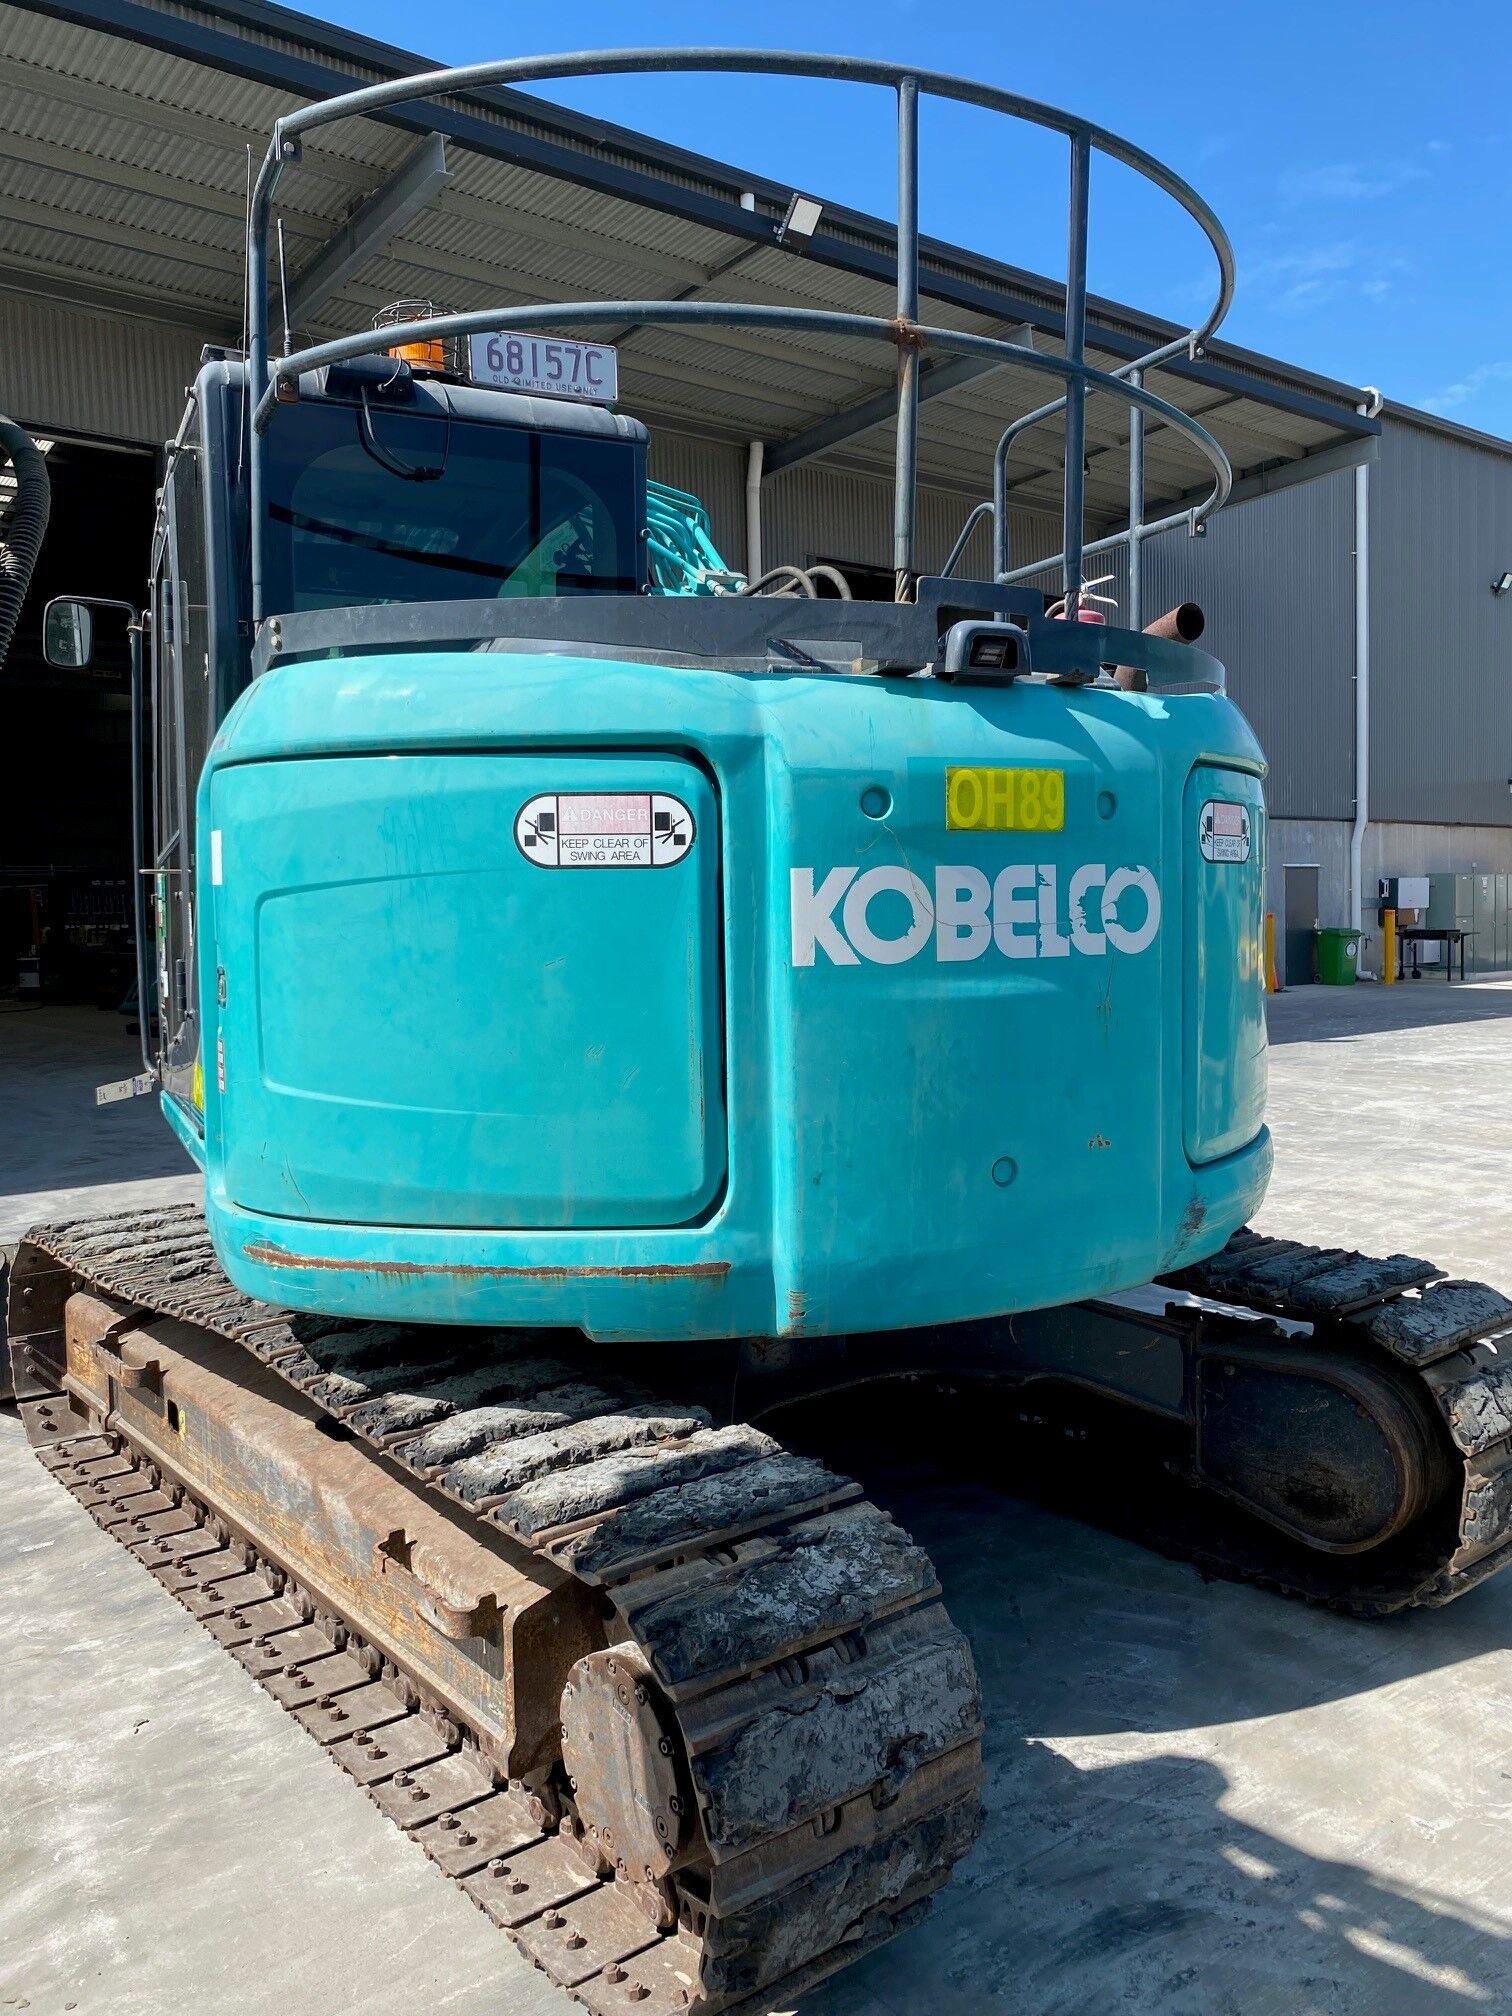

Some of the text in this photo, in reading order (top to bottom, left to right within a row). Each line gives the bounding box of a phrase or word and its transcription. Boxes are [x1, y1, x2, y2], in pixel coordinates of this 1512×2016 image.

[487, 337, 603, 385] 68157C
[492, 374, 510, 385] QLD
[555, 383, 573, 393] USE
[574, 385, 599, 396] NLY
[948, 769, 1064, 829] OH89
[581, 808, 648, 822] DANGER
[561, 838, 649, 849] KEEP CLEAR OF
[570, 850, 641, 861] SWING AREA
[790, 863, 1161, 967] KOBELCO
